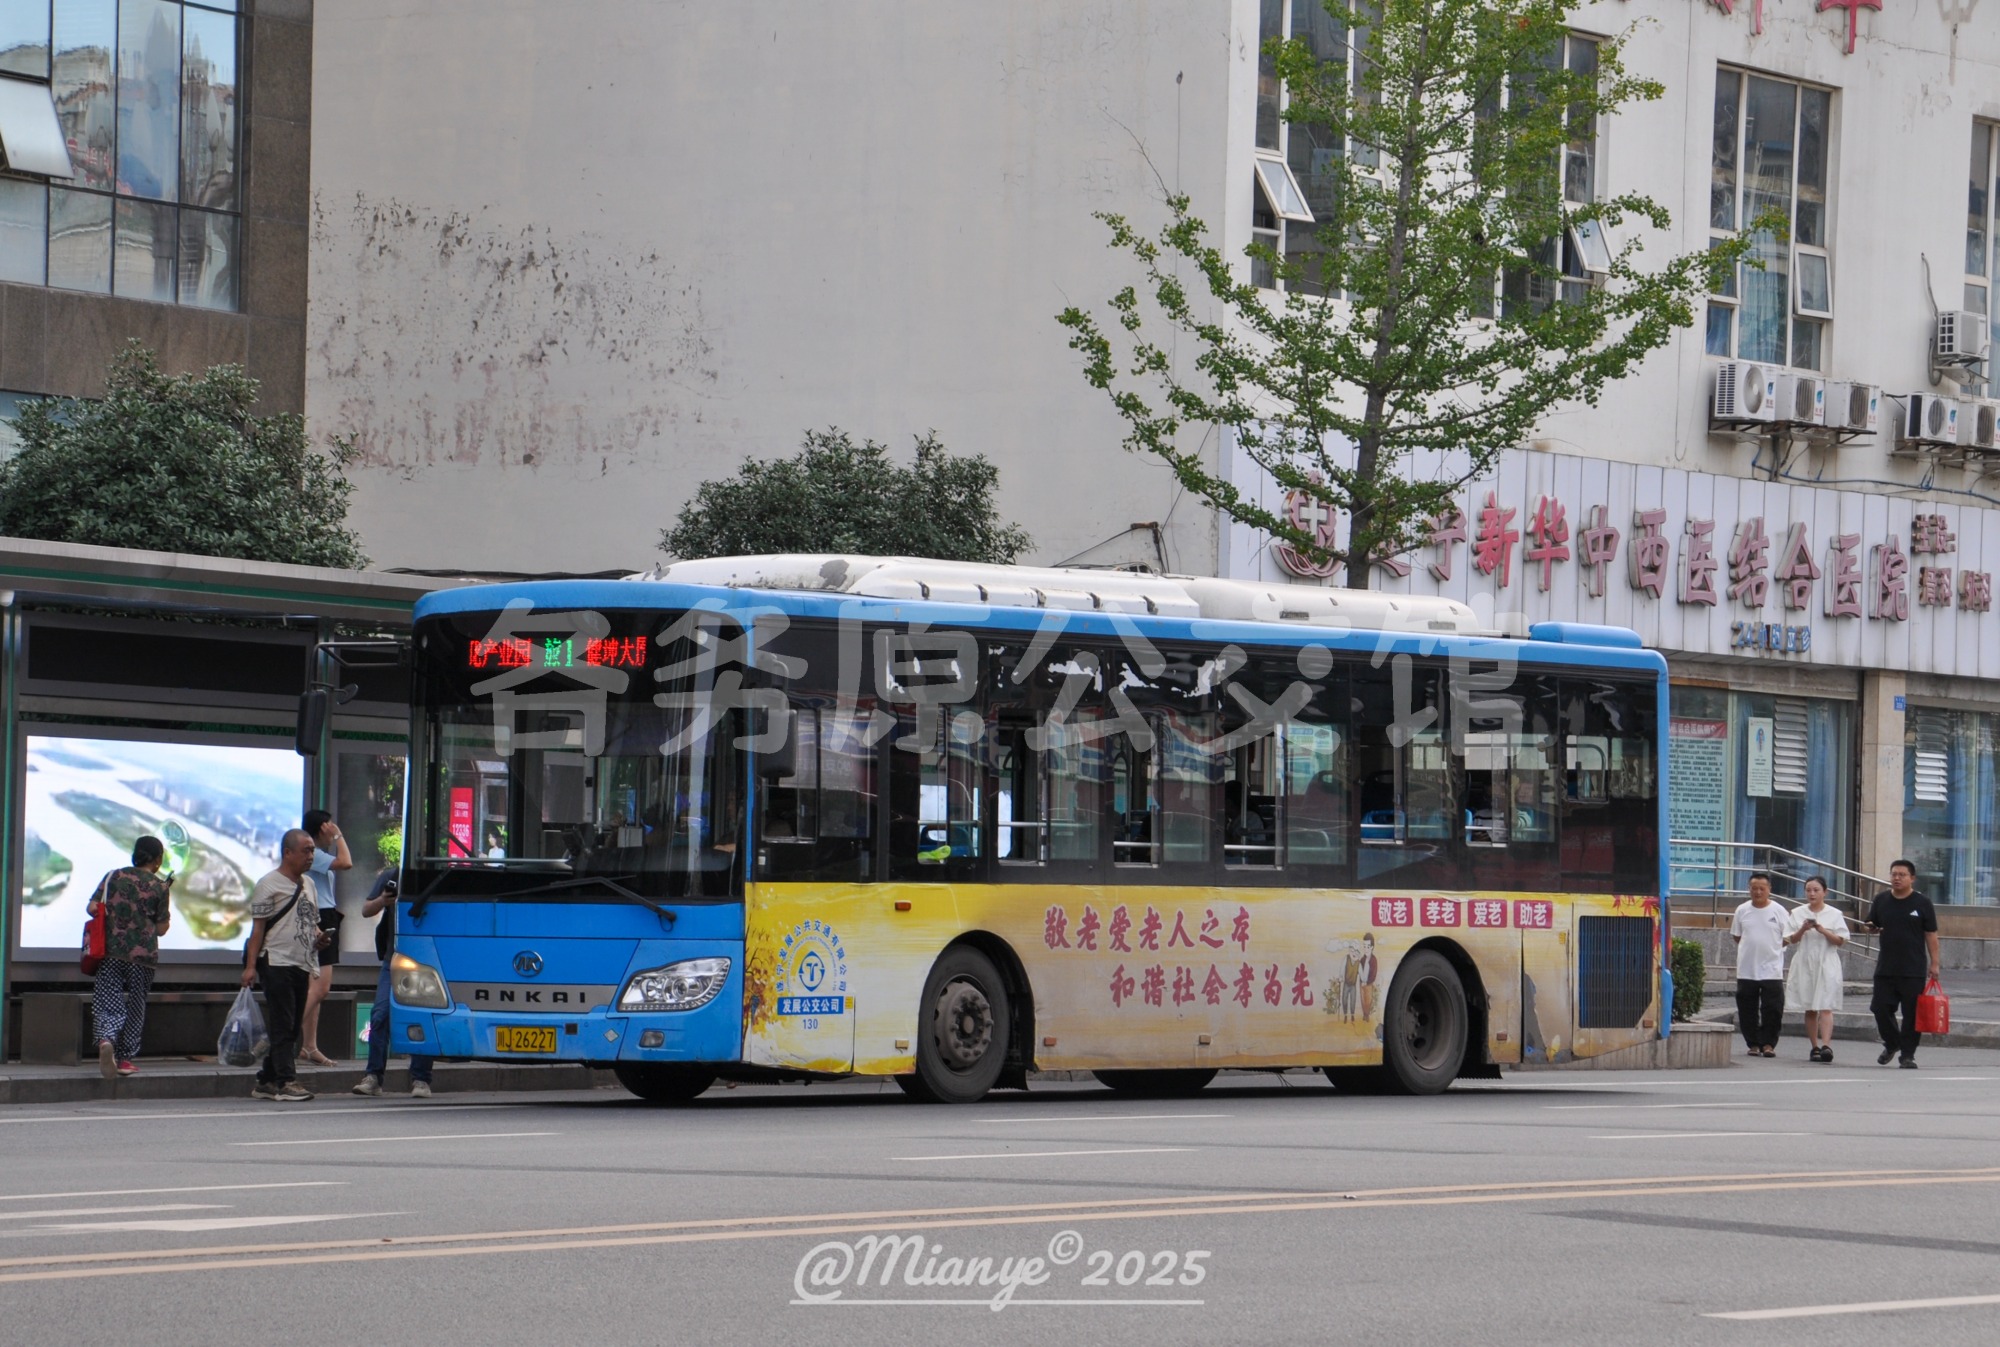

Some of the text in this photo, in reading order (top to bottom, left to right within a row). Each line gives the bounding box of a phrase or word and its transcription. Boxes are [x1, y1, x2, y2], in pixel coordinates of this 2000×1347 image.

[1378, 899, 1547, 927] 敬老 孝老 爱老 助老
[1044, 903, 1252, 953] 敬老爱老人之本
[475, 988, 586, 1004] ANKAI
[1109, 962, 1314, 1009] 和谐社会孝为先
[782, 998, 840, 1014] 发展公交公司
[803, 1018, 819, 1030] 130
